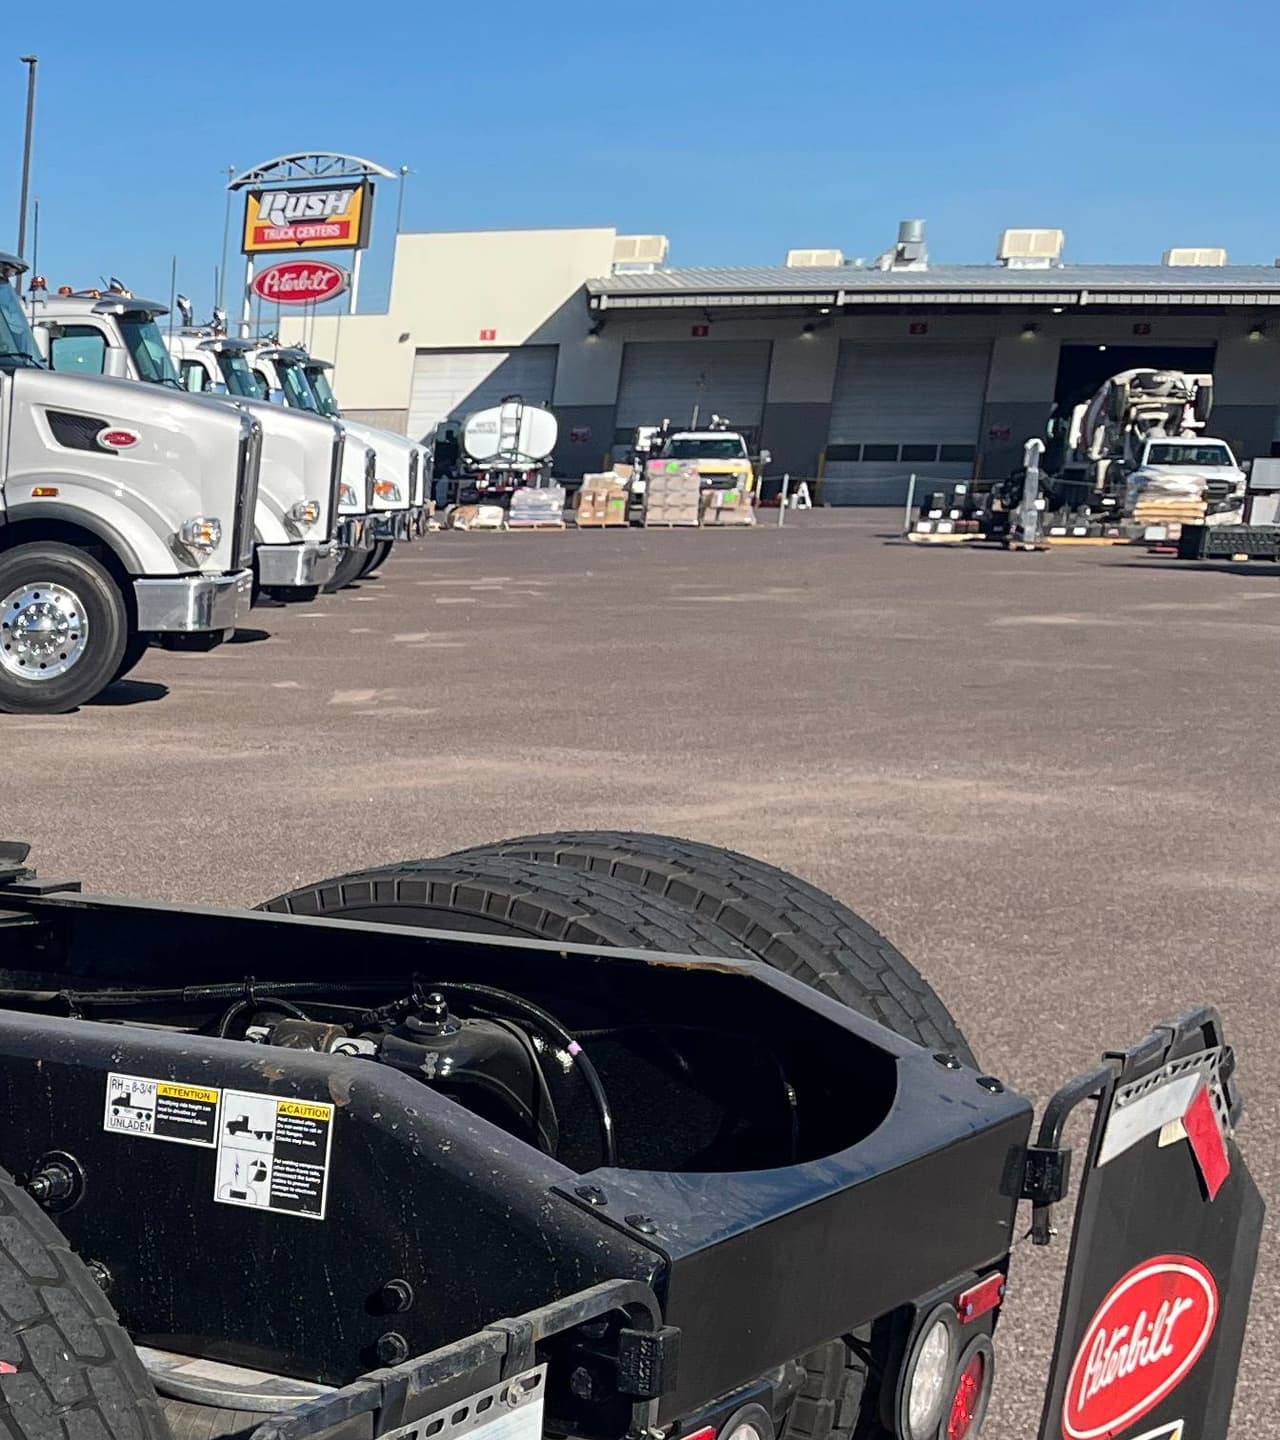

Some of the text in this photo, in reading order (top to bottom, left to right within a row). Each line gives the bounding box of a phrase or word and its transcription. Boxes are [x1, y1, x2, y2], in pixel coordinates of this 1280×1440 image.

[256, 190, 354, 227] RUSH
[263, 223, 341, 240] TRUCK CENTERS
[263, 269, 337, 294] Peterbilt
[162, 1087, 211, 1101] ATTENTION
[287, 1105, 329, 1118] CAUTION
[110, 1117, 152, 1132] UNLADEN
[1077, 1296, 1194, 1413] Peterbilt
